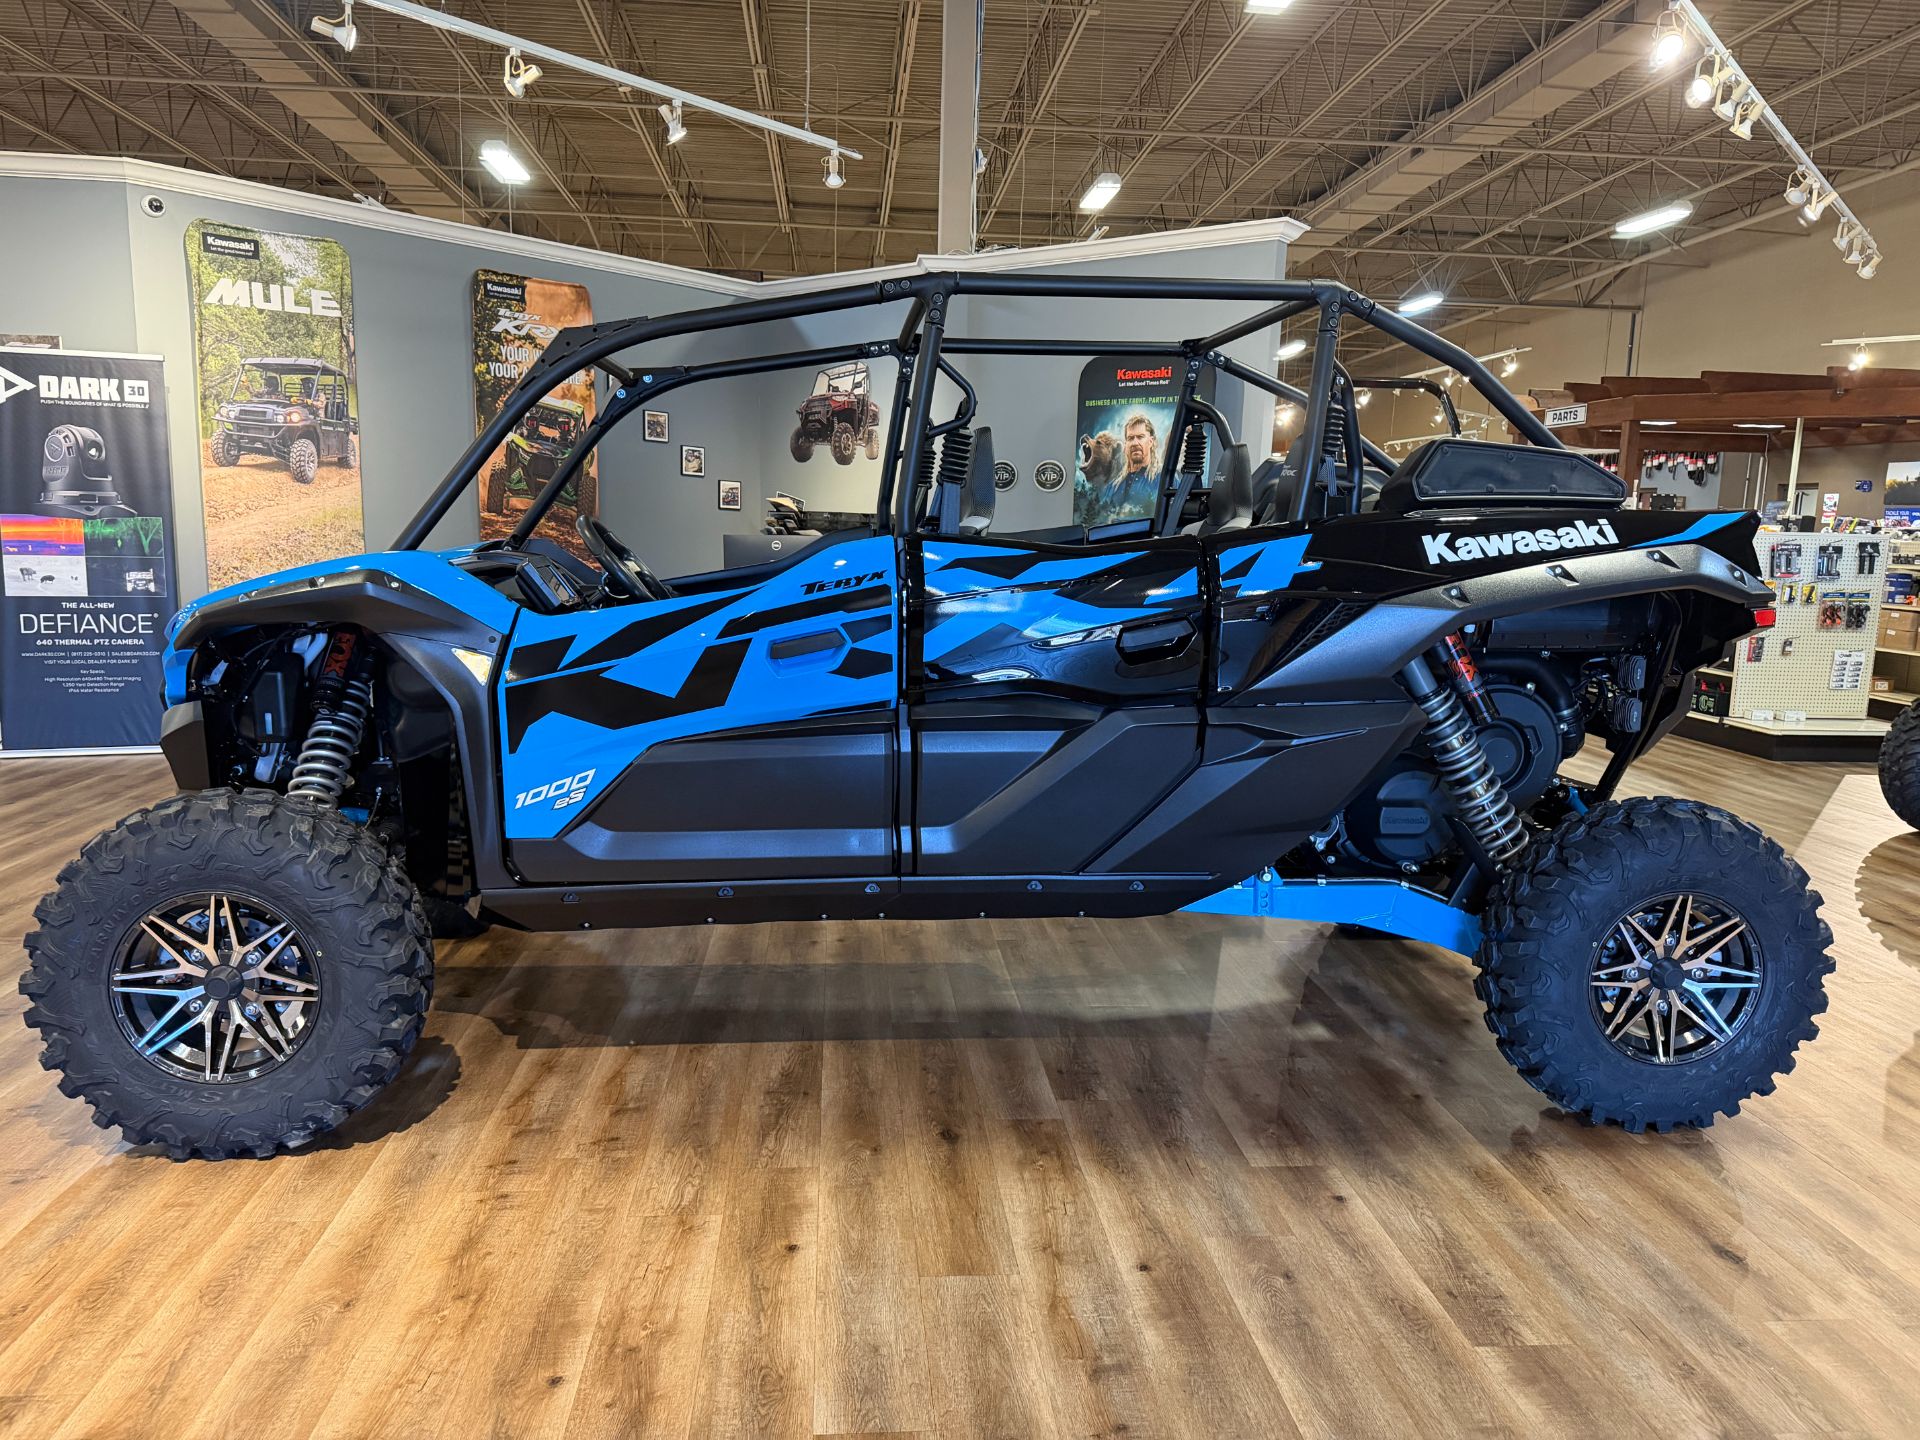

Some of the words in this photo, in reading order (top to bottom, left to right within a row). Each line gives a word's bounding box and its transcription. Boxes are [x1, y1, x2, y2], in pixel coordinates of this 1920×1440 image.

[206, 236, 255, 251] Kawasaki
[487, 283, 522, 294] Kawasaki
[204, 278, 342, 317] MULE
[500, 345, 529, 362] YOUR
[489, 362, 518, 378] YOUR
[1117, 366, 1172, 380] Kawasaki
[39, 375, 121, 401] DARK
[1085, 399, 1111, 407] BUSINESS
[1552, 410, 1578, 422] PARTS
[1421, 518, 1620, 565] Kawasaki
[800, 569, 888, 595] TERYX
[514, 768, 596, 810] 1000
